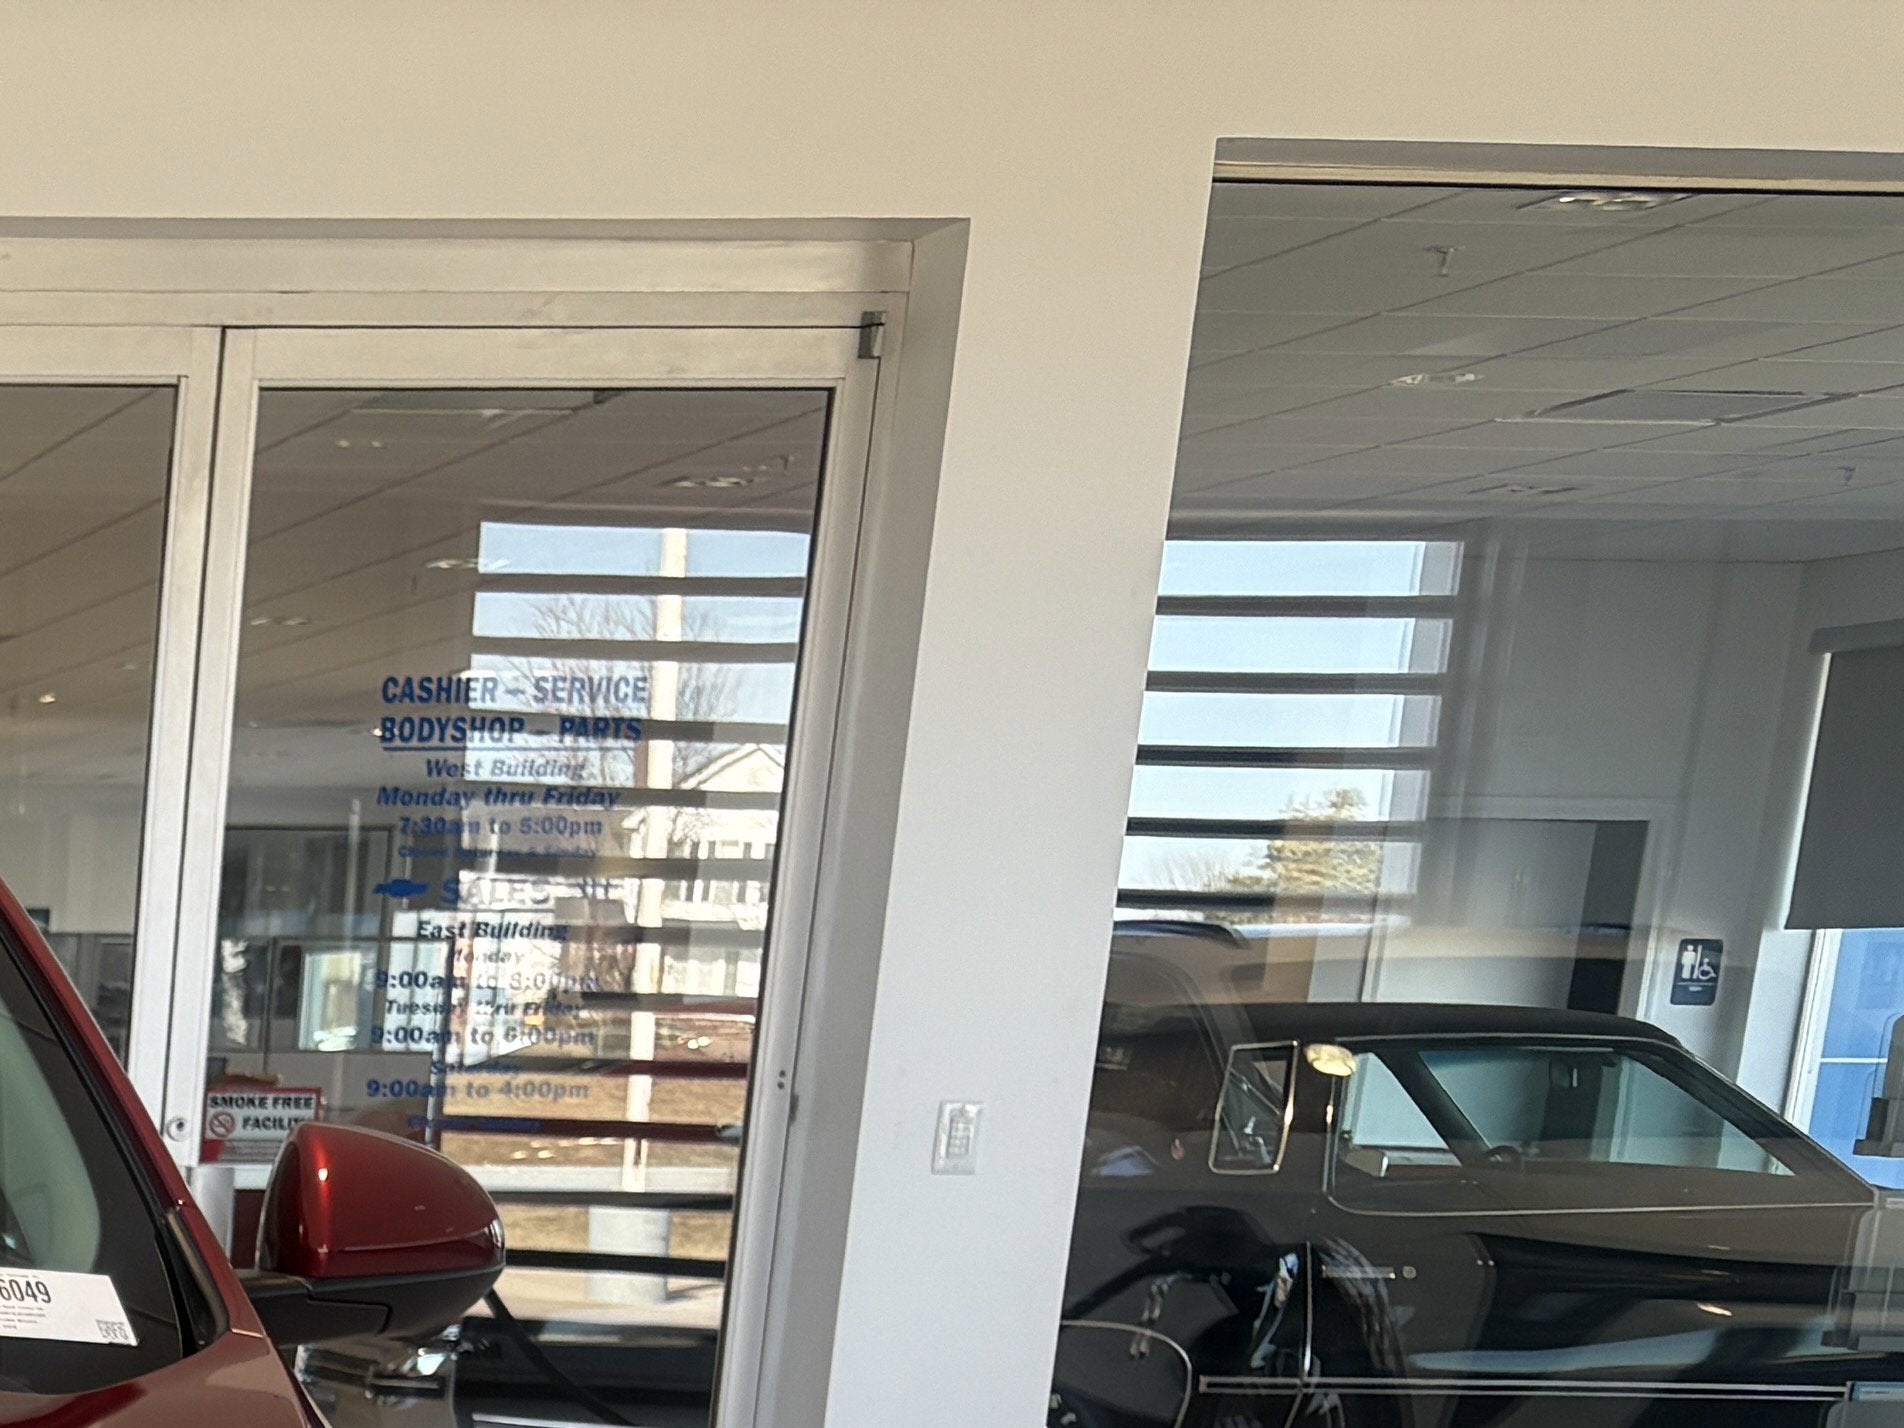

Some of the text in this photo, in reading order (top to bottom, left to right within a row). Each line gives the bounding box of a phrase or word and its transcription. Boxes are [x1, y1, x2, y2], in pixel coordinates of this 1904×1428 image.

[381, 676, 498, 705] CASHIER
[533, 676, 648, 705] SERVICE
[379, 717, 525, 744] BODYSHOP
[558, 717, 643, 742] PARTS
[426, 759, 586, 782] West Building
[377, 786, 621, 809] Monday thru Friday
[399, 815, 603, 838] 7:30am to 5:00pm
[440, 877, 552, 905] SALES
[416, 920, 569, 942] East Building
[375, 970, 468, 990] 9:00am
[371, 1026, 462, 1044] 9:00am
[470, 1027, 495, 1044] to
[366, 1079, 591, 1101] 9:00am to 4:00pm
[208, 1095, 313, 1110] SMOKE FREE
[241, 1115, 307, 1131] FACILIT
